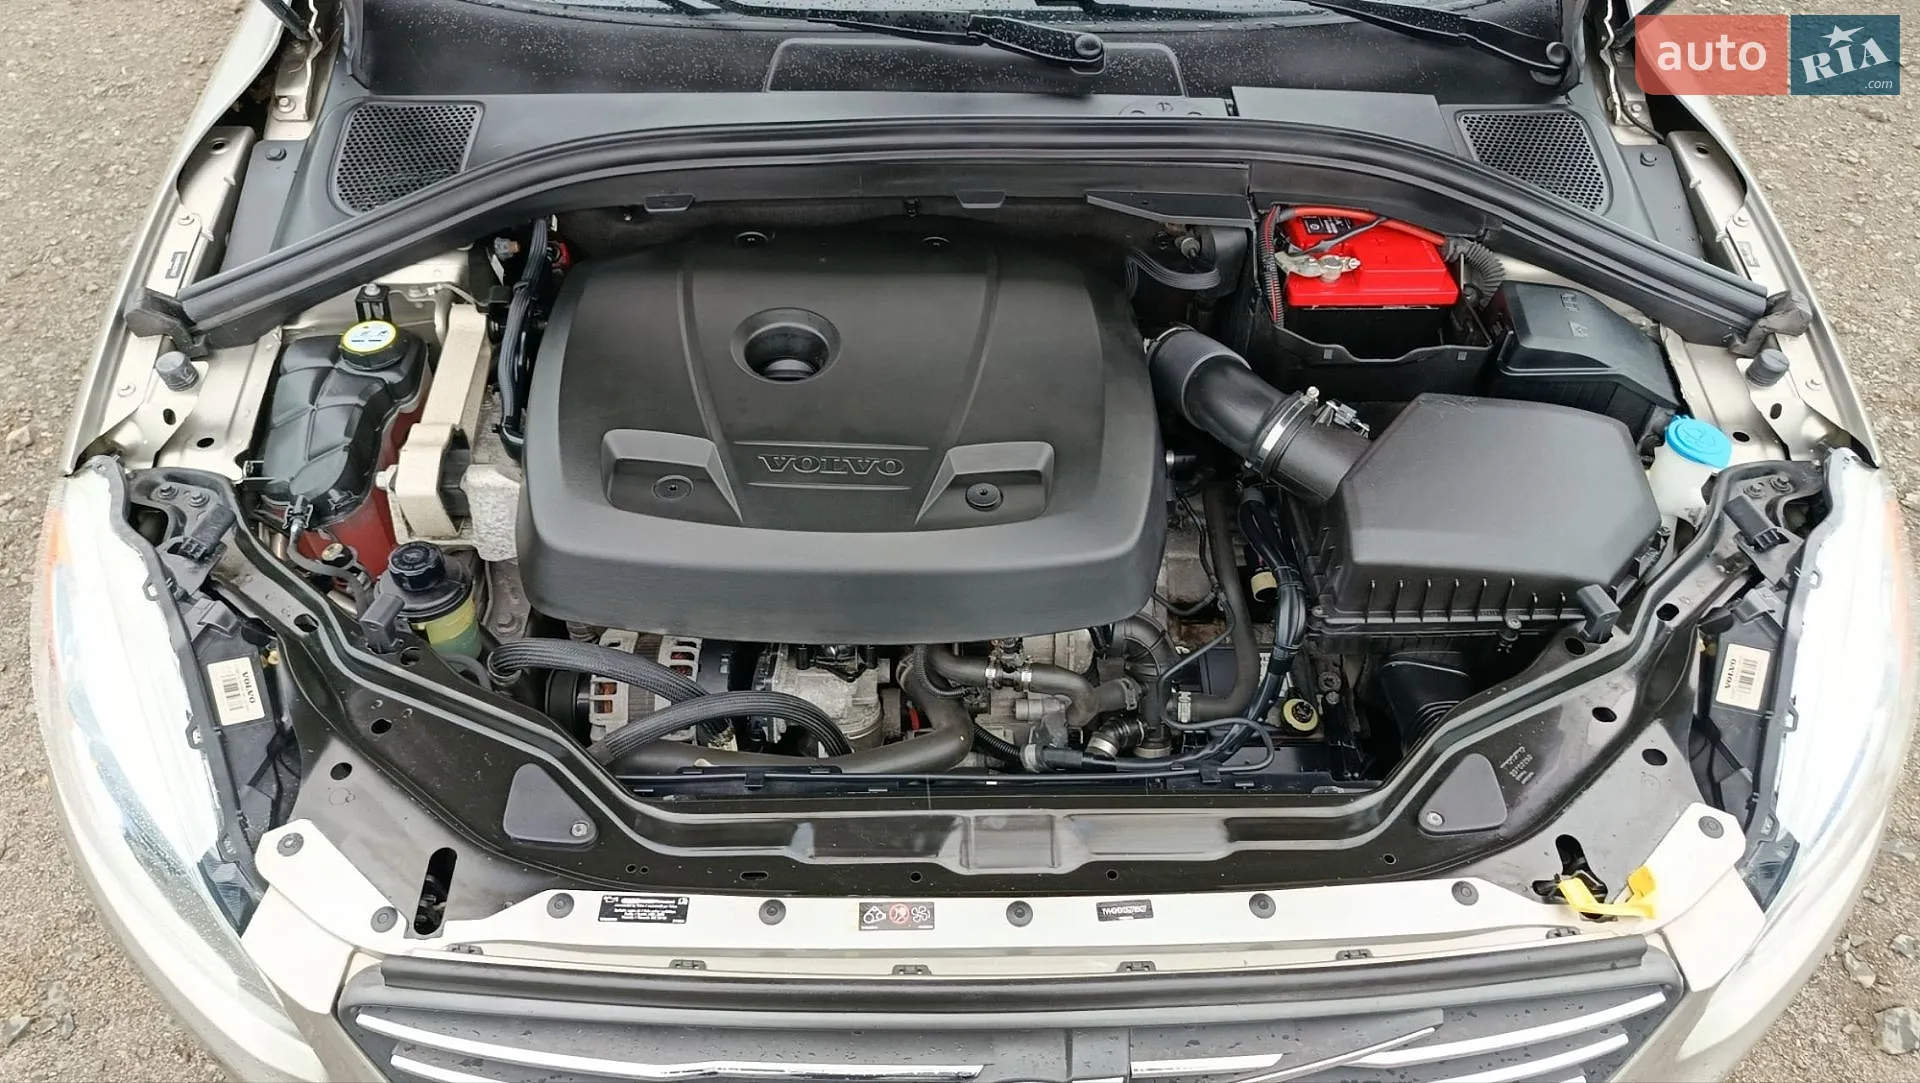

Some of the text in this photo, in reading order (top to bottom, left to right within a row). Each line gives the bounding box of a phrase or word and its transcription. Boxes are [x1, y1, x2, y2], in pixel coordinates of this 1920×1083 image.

[757, 454, 905, 476] VOLVO
[242, 671, 256, 704] VOLVO
[1724, 658, 1737, 689] VOLVO
